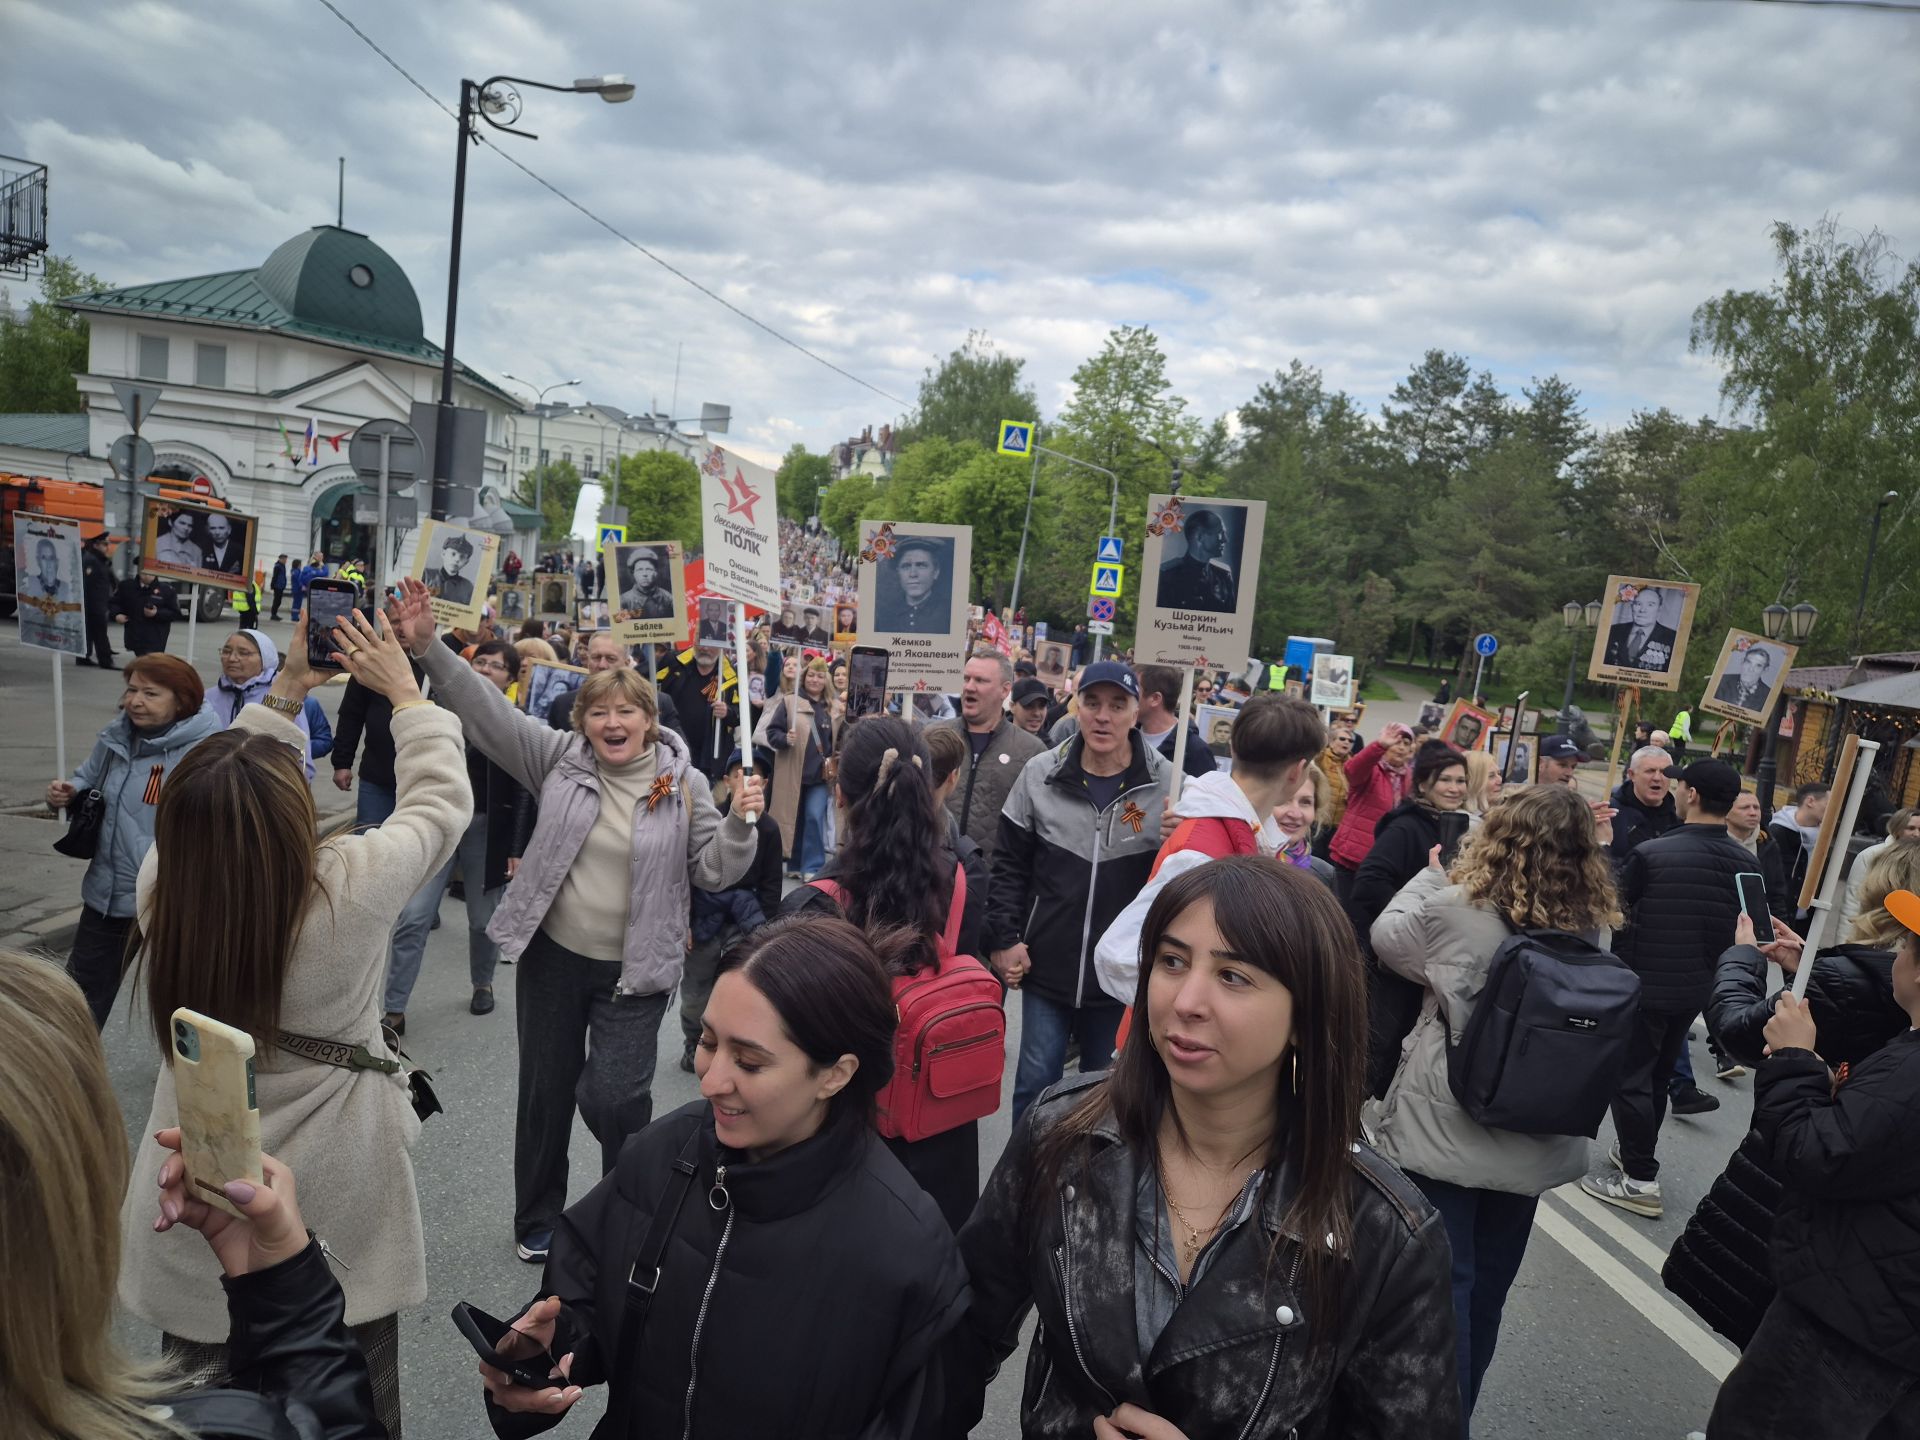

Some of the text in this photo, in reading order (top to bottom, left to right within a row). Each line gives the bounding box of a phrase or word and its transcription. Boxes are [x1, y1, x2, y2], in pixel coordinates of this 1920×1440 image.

[724, 530, 761, 556] ПОЛК
[728, 558, 759, 577] Оюшин
[708, 562, 778, 596] Петр Васильевич
[1172, 610, 1217, 623] Шоркин
[633, 622, 664, 631] Баблев
[1154, 619, 1234, 635] Кузьма Ильич
[891, 637, 932, 647] Жемков
[904, 649, 960, 659] Яковлевич
